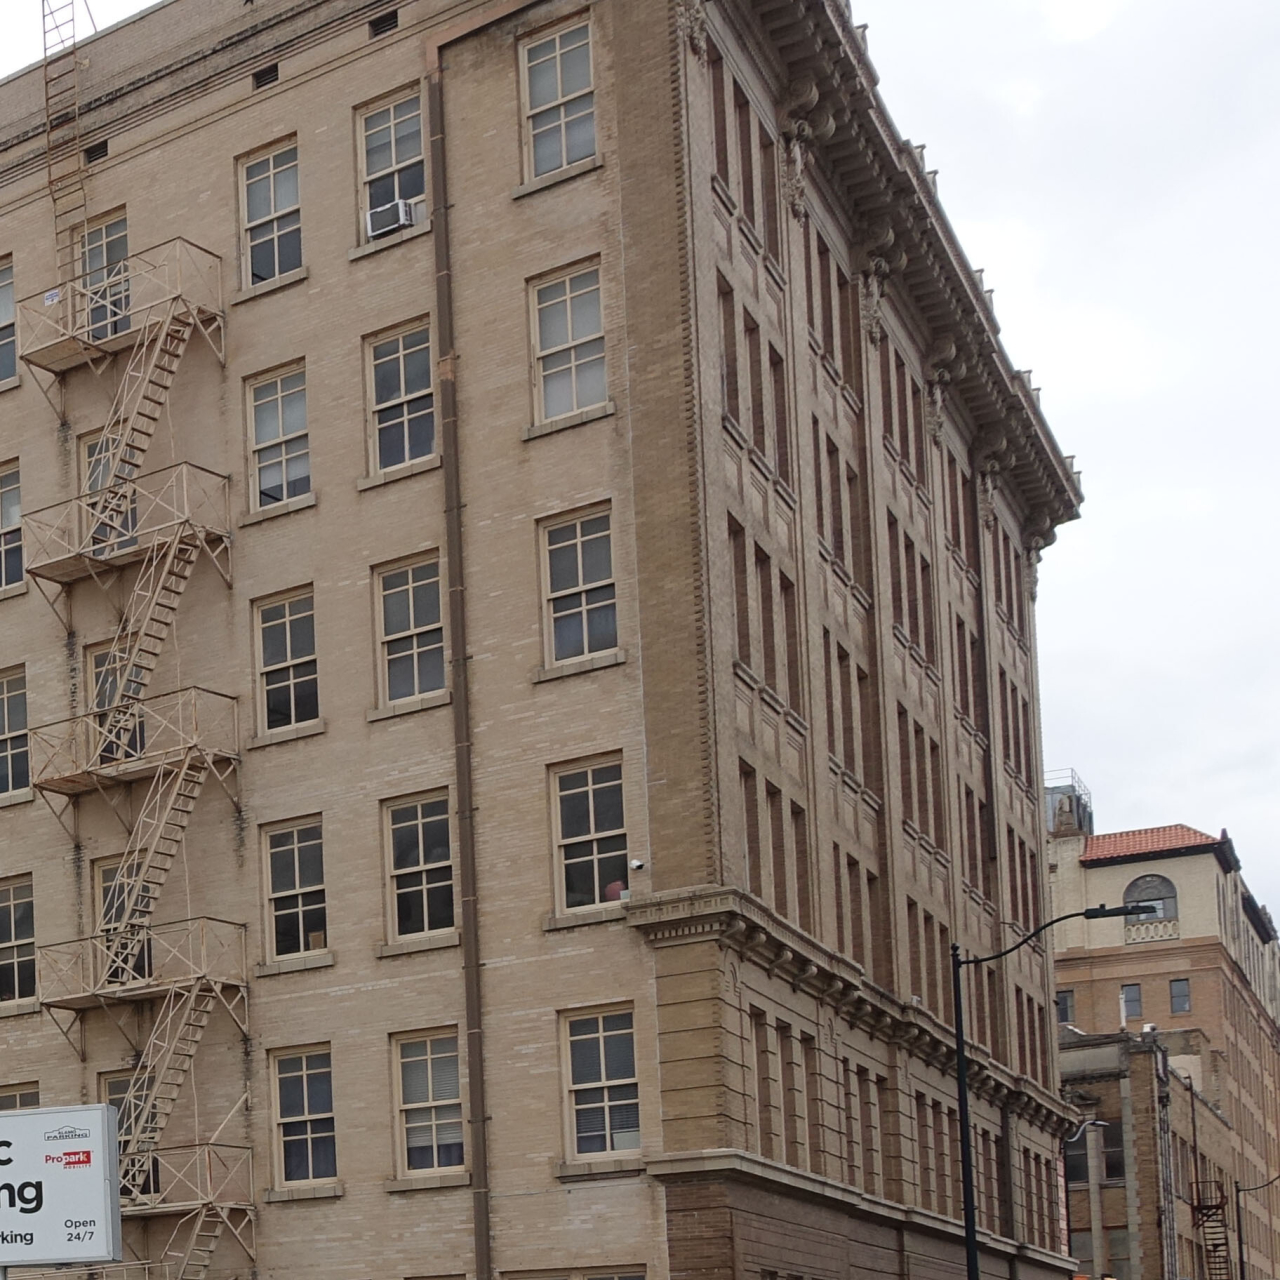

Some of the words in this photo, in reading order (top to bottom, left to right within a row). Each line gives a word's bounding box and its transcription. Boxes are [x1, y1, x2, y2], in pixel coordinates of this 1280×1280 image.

[46, 1132, 88, 1141] PARKING
[44, 1151, 89, 1164] Propark
[64, 1218, 97, 1229] Open
[66, 1231, 95, 1243] 24/7
